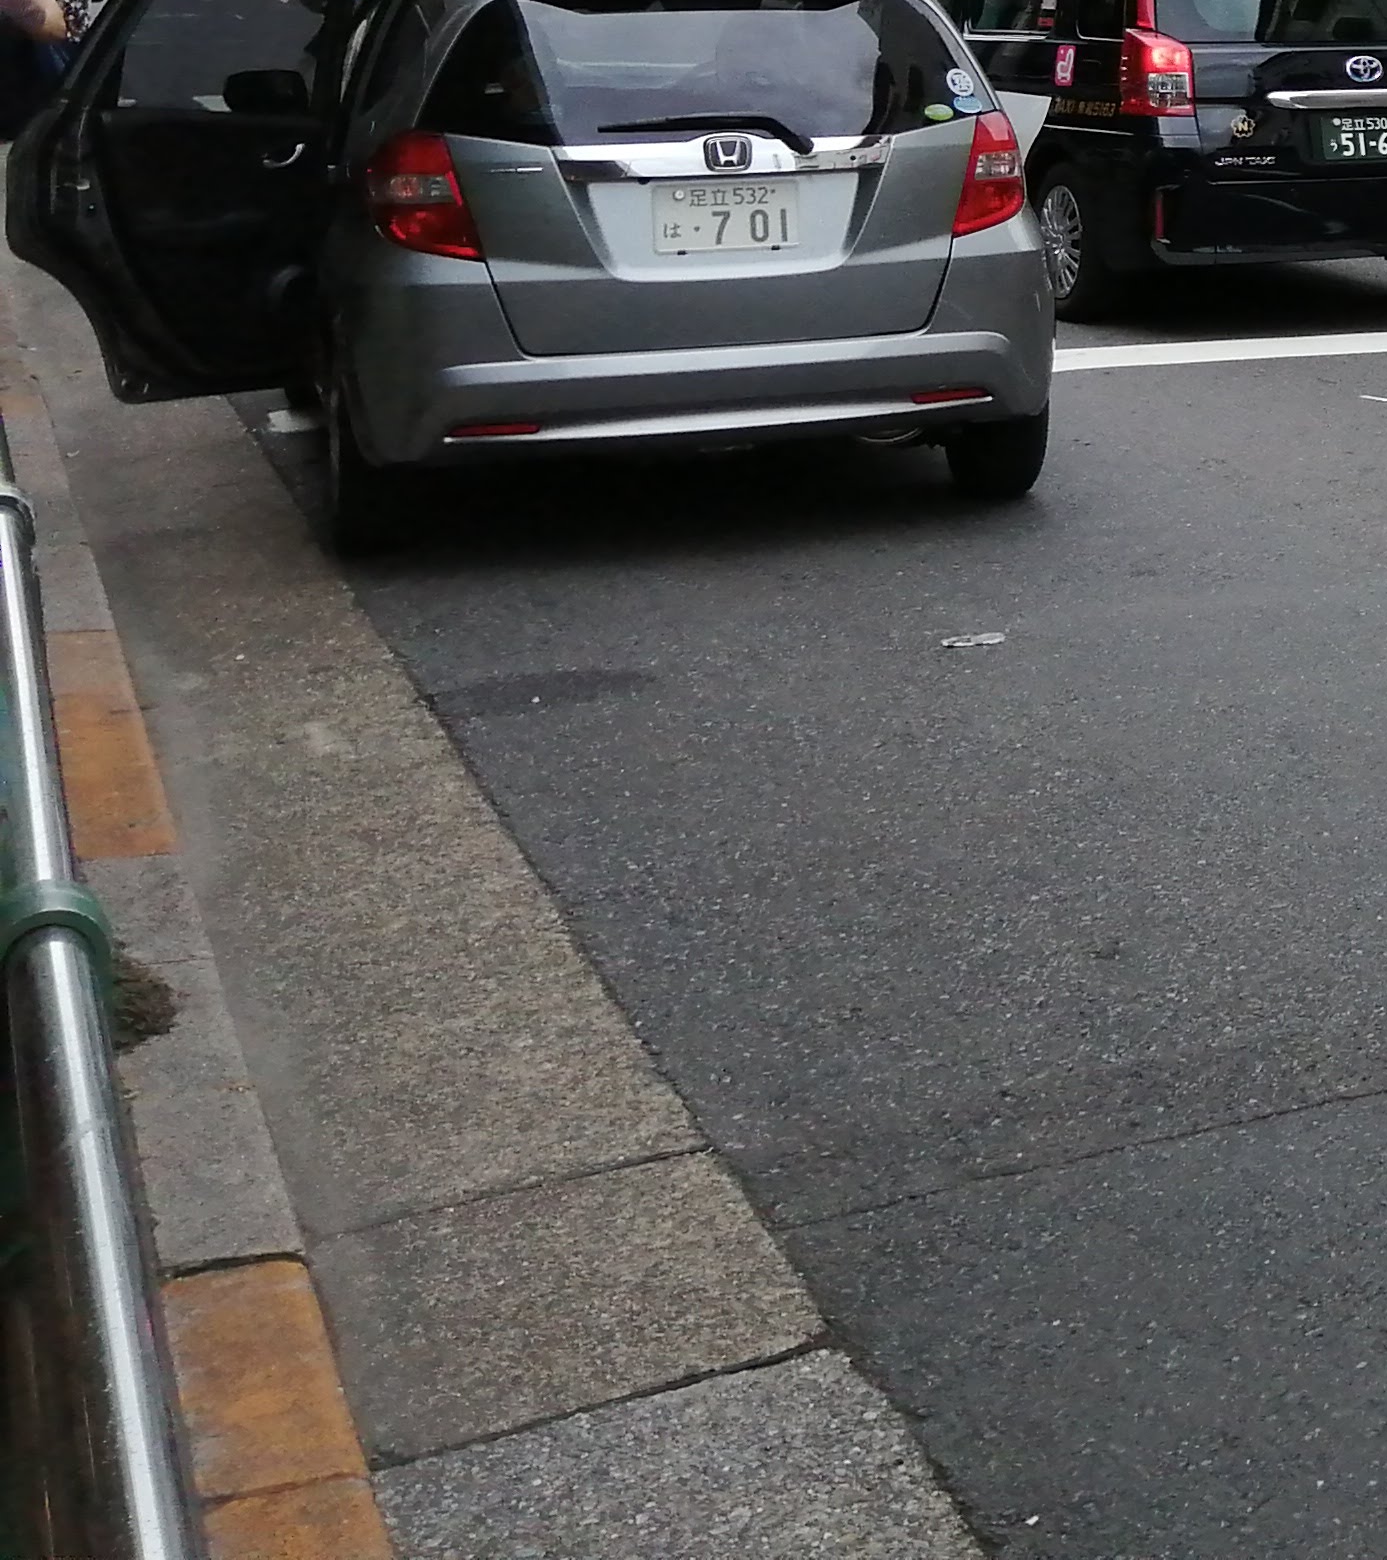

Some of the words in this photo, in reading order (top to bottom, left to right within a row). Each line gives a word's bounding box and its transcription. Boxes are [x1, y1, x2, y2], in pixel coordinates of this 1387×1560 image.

[1341, 117, 1366, 131] 足立
[689, 188, 730, 207] 足立
[732, 186, 769, 206] 532
[663, 223, 682, 238] は
